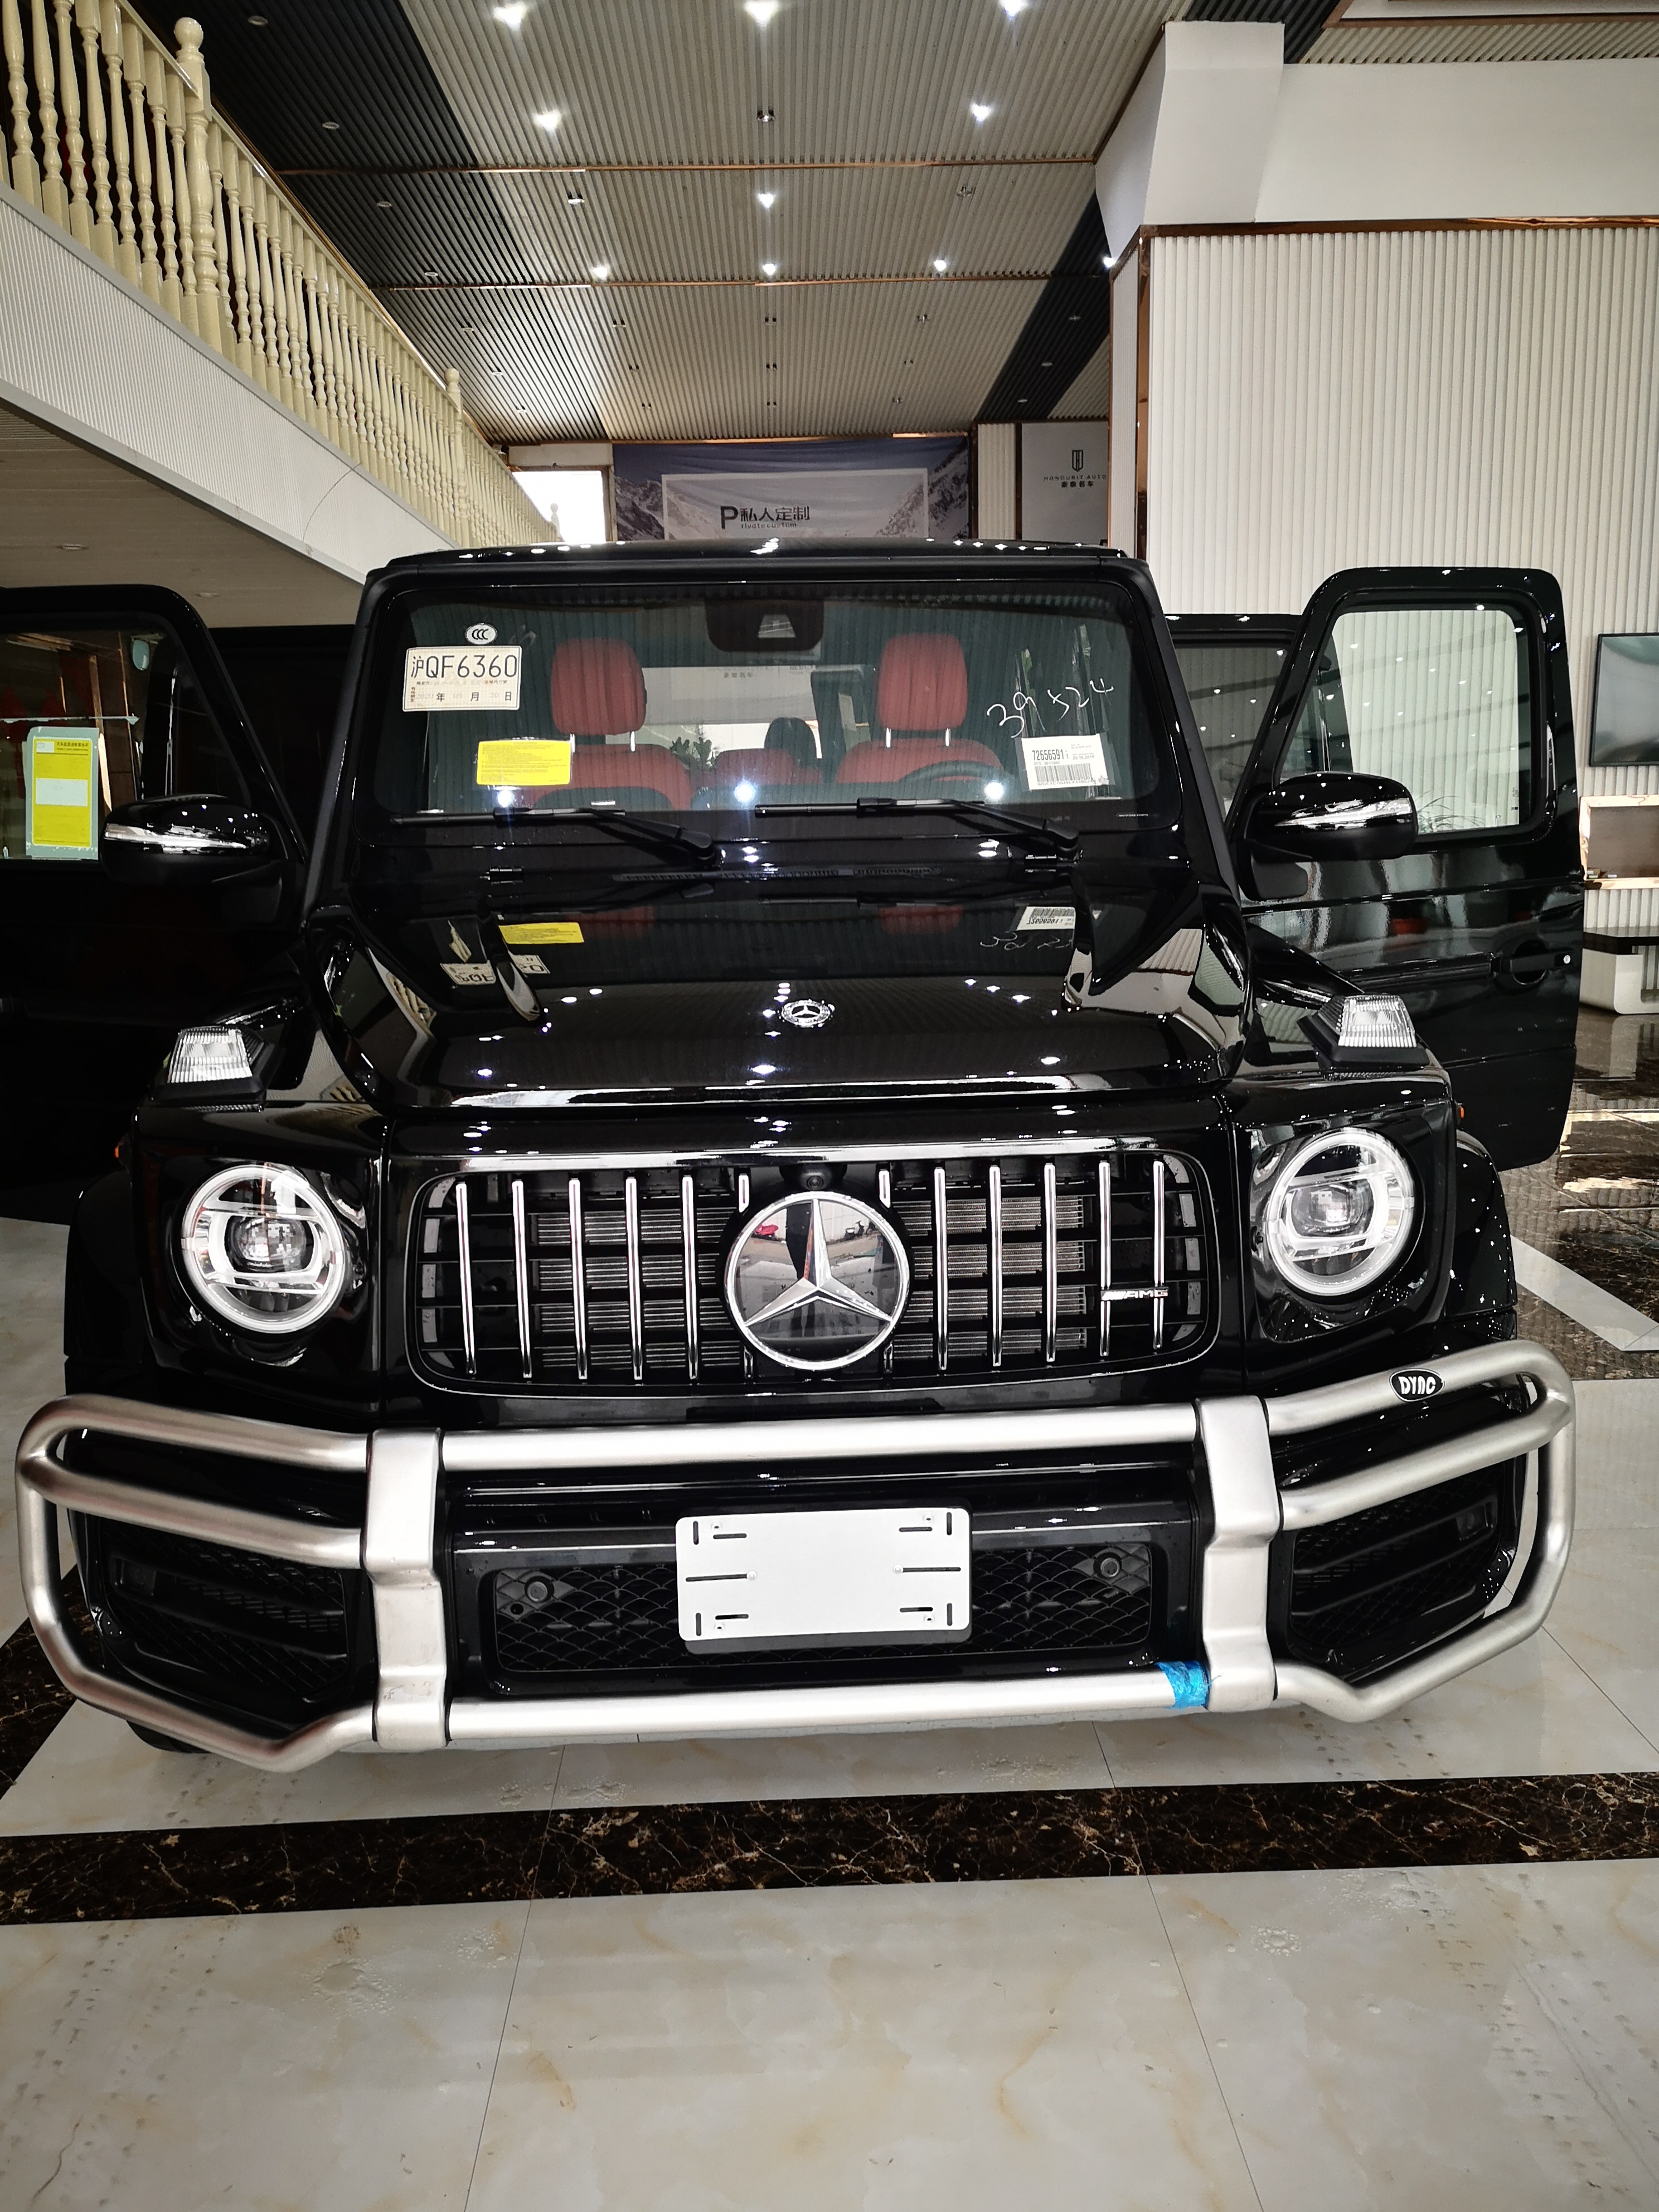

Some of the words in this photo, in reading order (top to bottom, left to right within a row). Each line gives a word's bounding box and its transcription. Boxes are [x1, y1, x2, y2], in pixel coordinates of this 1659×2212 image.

[411, 654, 517, 678] 沪QF6360
[436, 692, 445, 702] 年
[470, 692, 479, 702] 月
[505, 691, 512, 701] 日
[1032, 749, 1064, 761] 72656591
[1124, 1289, 1168, 1299] AMG
